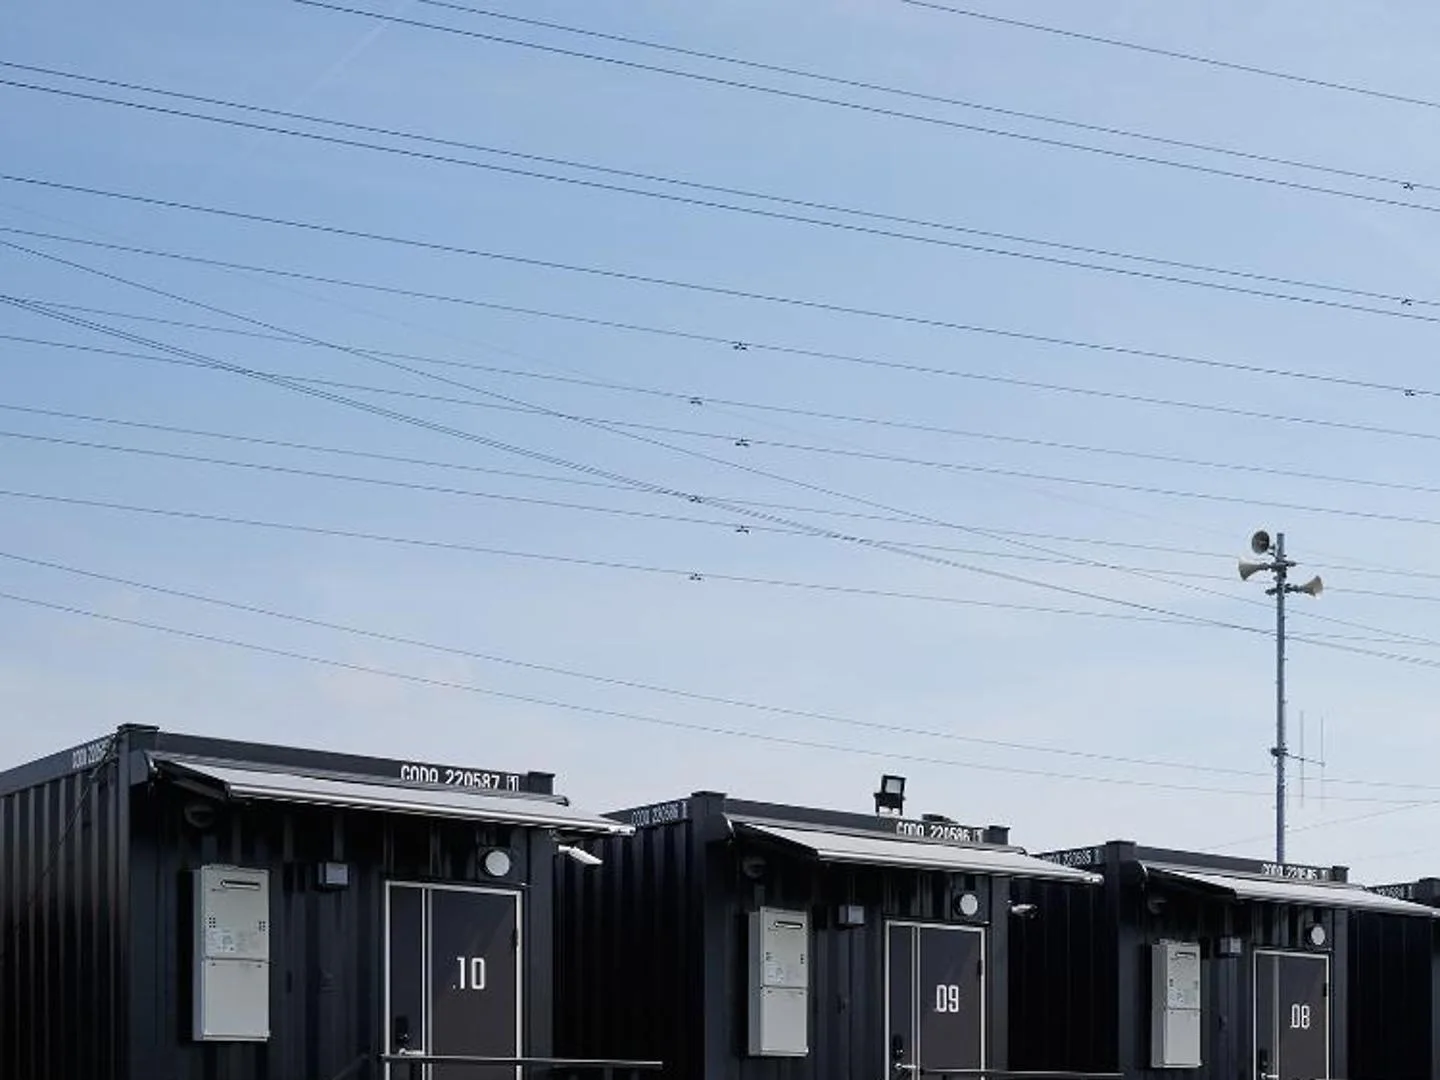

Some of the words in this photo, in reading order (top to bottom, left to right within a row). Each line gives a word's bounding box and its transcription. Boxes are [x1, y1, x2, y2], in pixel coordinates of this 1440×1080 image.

[444, 769, 500, 790] 220587
[936, 984, 959, 1013] 09
[1291, 1003, 1310, 1029] 08
